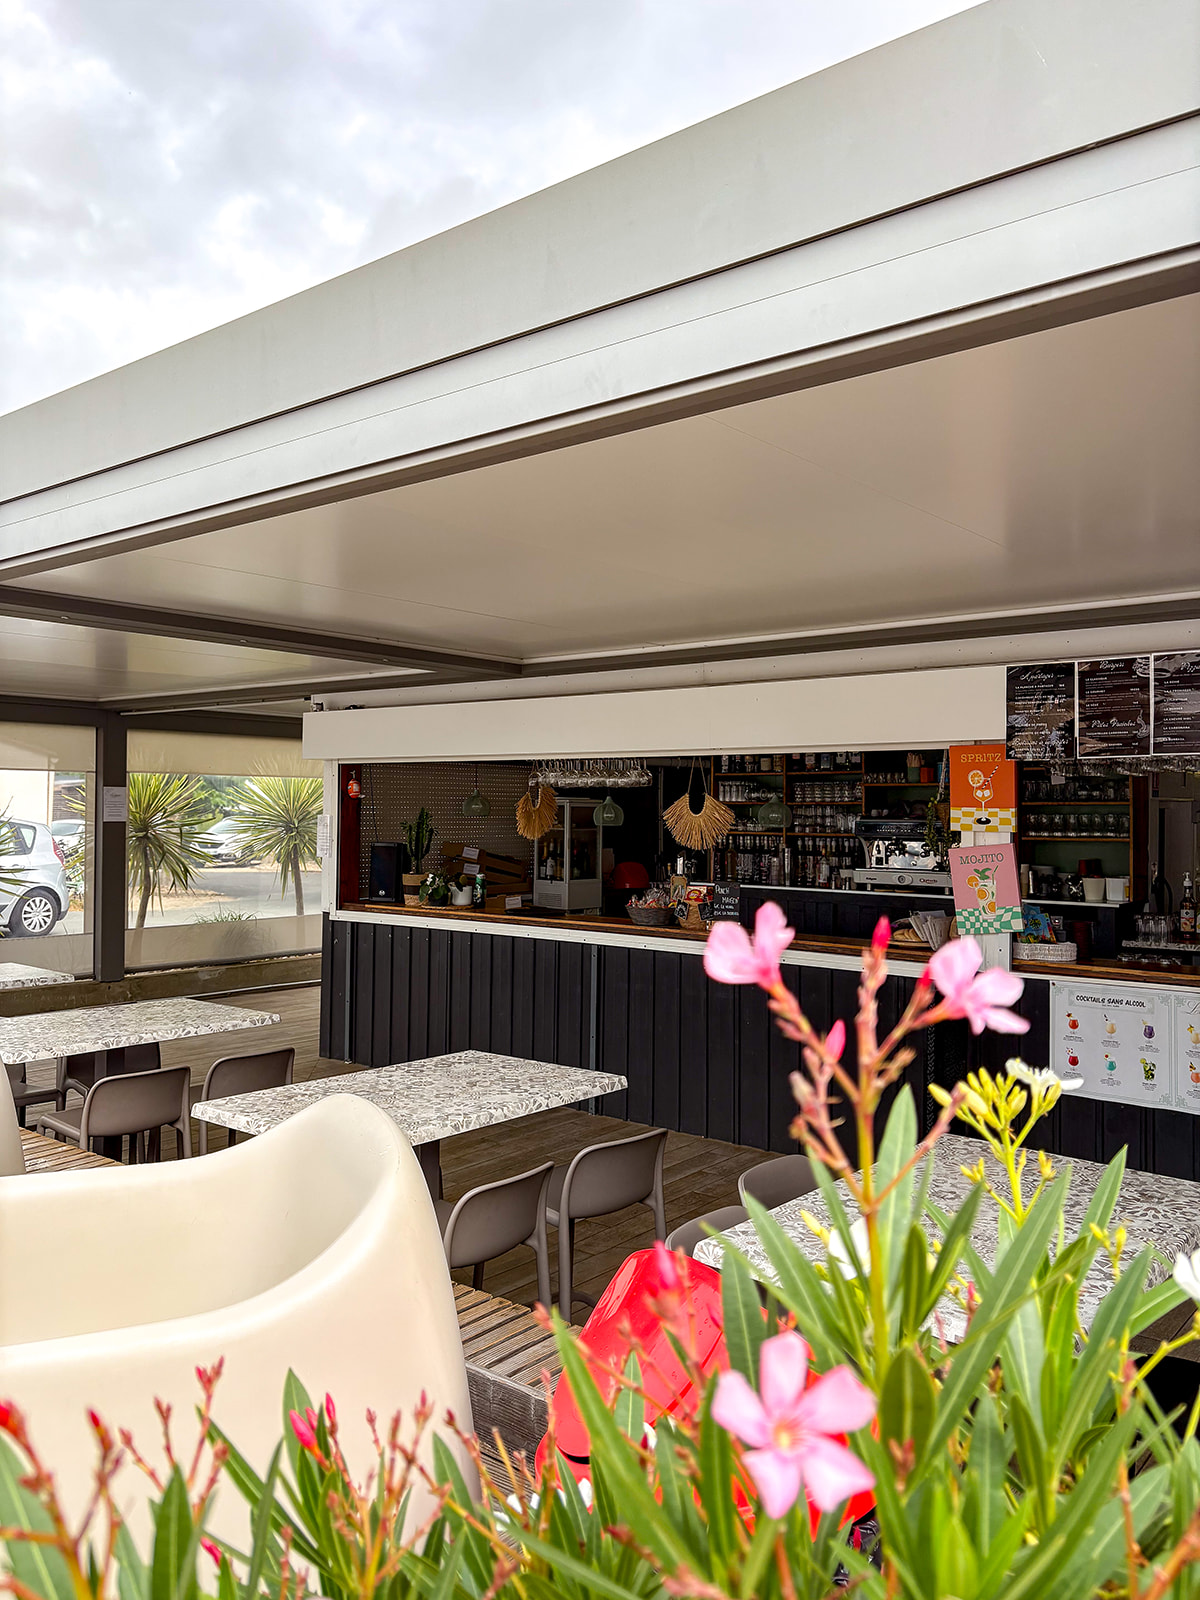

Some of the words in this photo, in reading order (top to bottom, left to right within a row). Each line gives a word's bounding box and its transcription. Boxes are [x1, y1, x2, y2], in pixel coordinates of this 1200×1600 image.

[960, 753, 1001, 763] SPRITZ
[959, 852, 1004, 865] MOJITO
[1075, 994, 1106, 1004] COCKTAILS
[1107, 997, 1124, 1006] SANS
[1125, 999, 1146, 1008] ALCOOL
